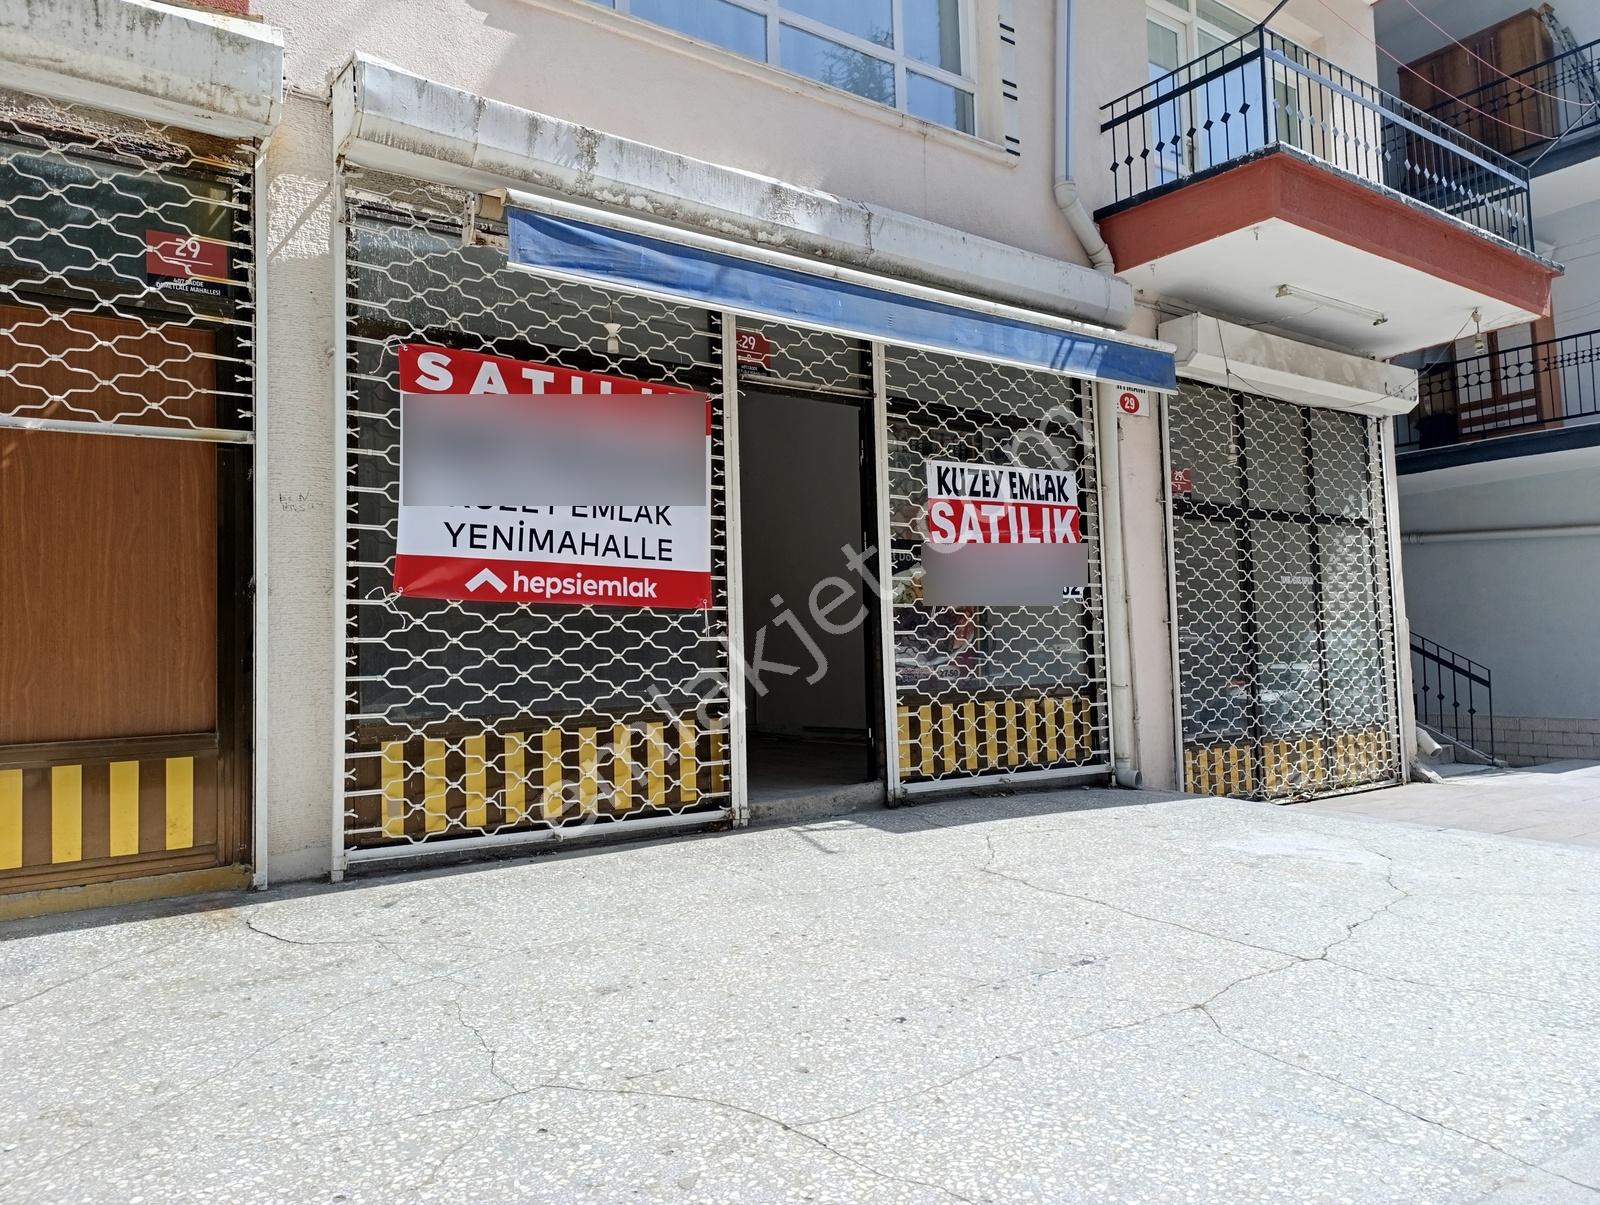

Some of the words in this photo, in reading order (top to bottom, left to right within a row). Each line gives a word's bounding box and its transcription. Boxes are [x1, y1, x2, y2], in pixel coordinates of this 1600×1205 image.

[175, 238, 200, 258] 29
[741, 335, 756, 350] 29
[415, 352, 678, 395] SATI
[1124, 396, 1135, 410] 29
[937, 465, 1004, 499] KUZEY
[1008, 471, 1069, 503] EMLAK
[930, 501, 1078, 544] SATILIK
[444, 520, 673, 562] YENİMAHALLE
[513, 570, 658, 599] hepsiemlak
